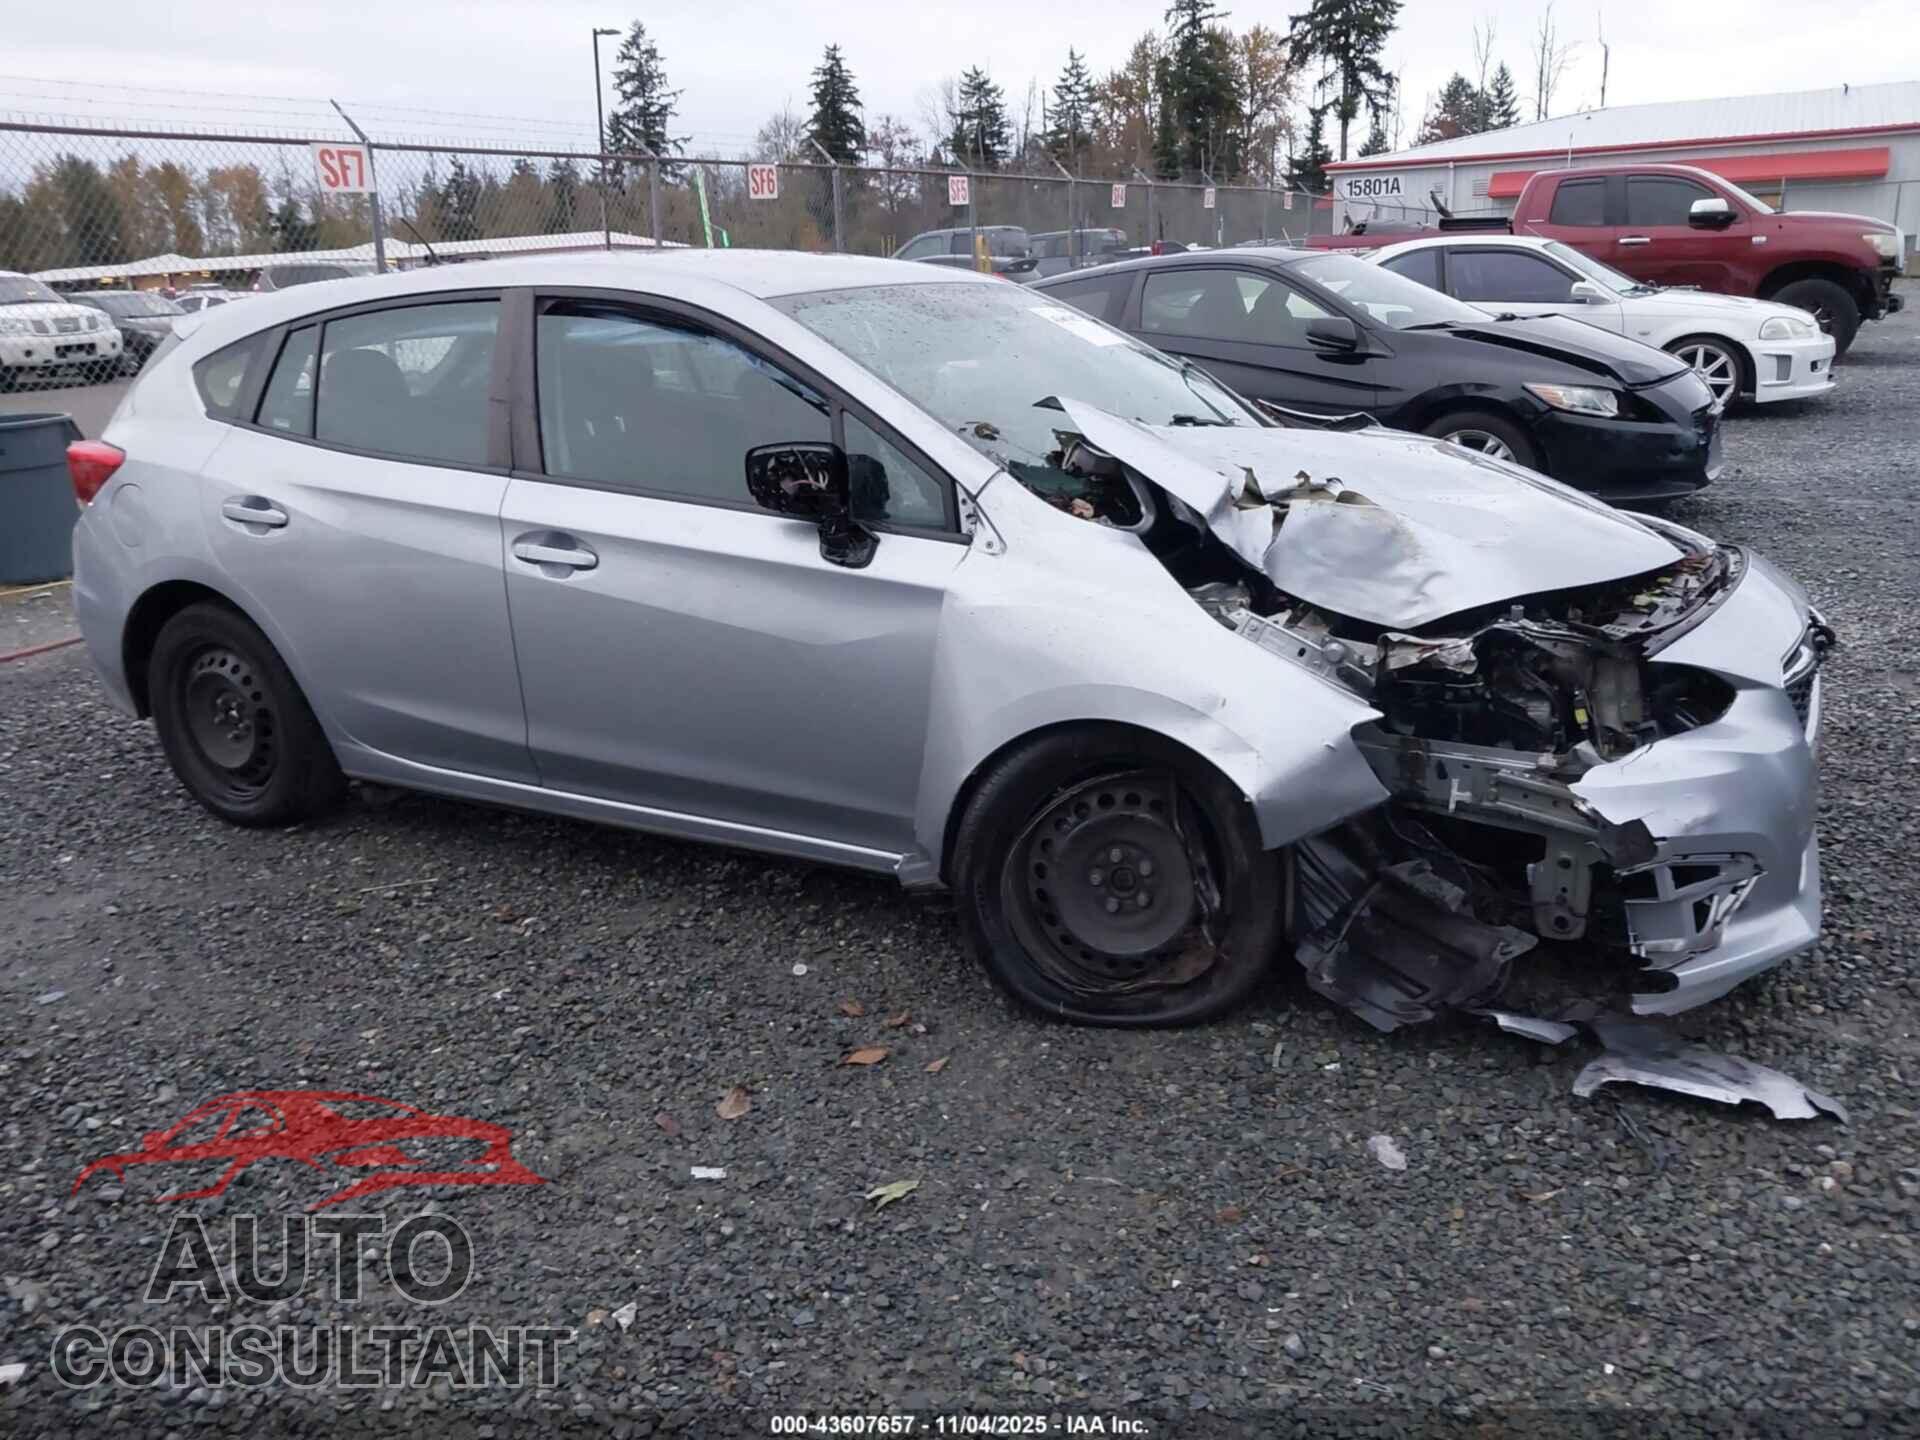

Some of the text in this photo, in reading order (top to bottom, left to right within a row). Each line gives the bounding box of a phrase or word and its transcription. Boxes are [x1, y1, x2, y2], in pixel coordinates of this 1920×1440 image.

[751, 166, 775, 195] SF6
[950, 178, 968, 202] SF5
[1346, 177, 1401, 197] 15801A
